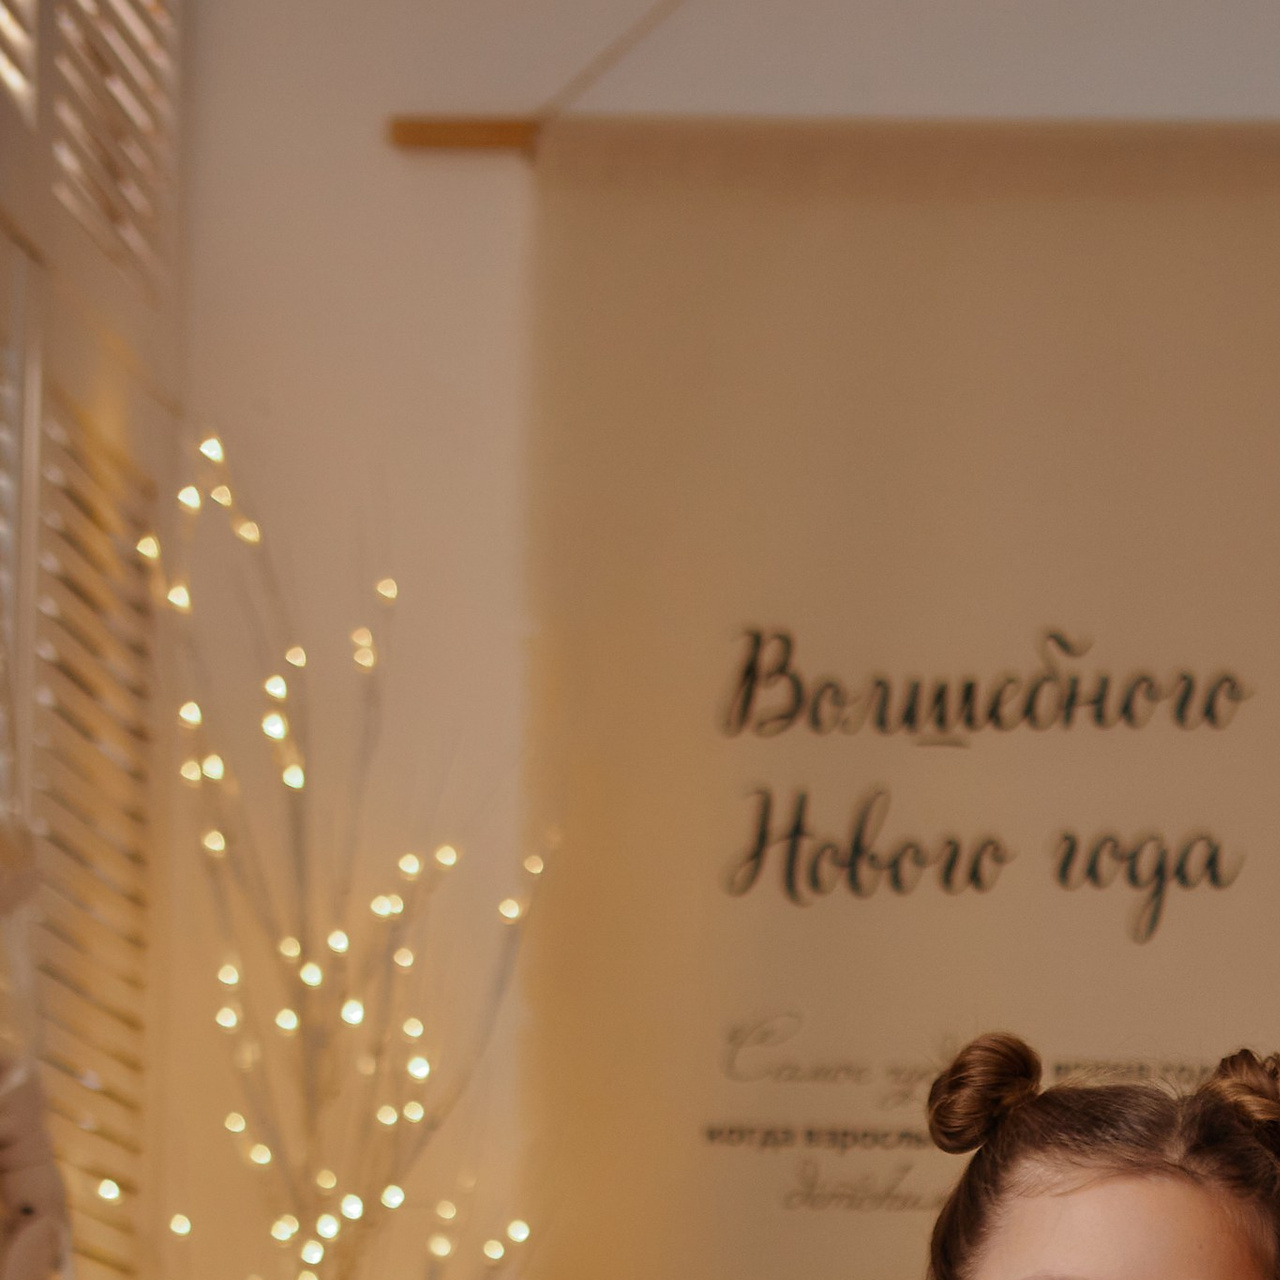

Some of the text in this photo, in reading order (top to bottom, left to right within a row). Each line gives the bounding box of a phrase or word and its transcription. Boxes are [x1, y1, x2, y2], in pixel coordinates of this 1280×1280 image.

[721, 626, 1250, 747] Волшебного
[727, 787, 1240, 943] Нового года
